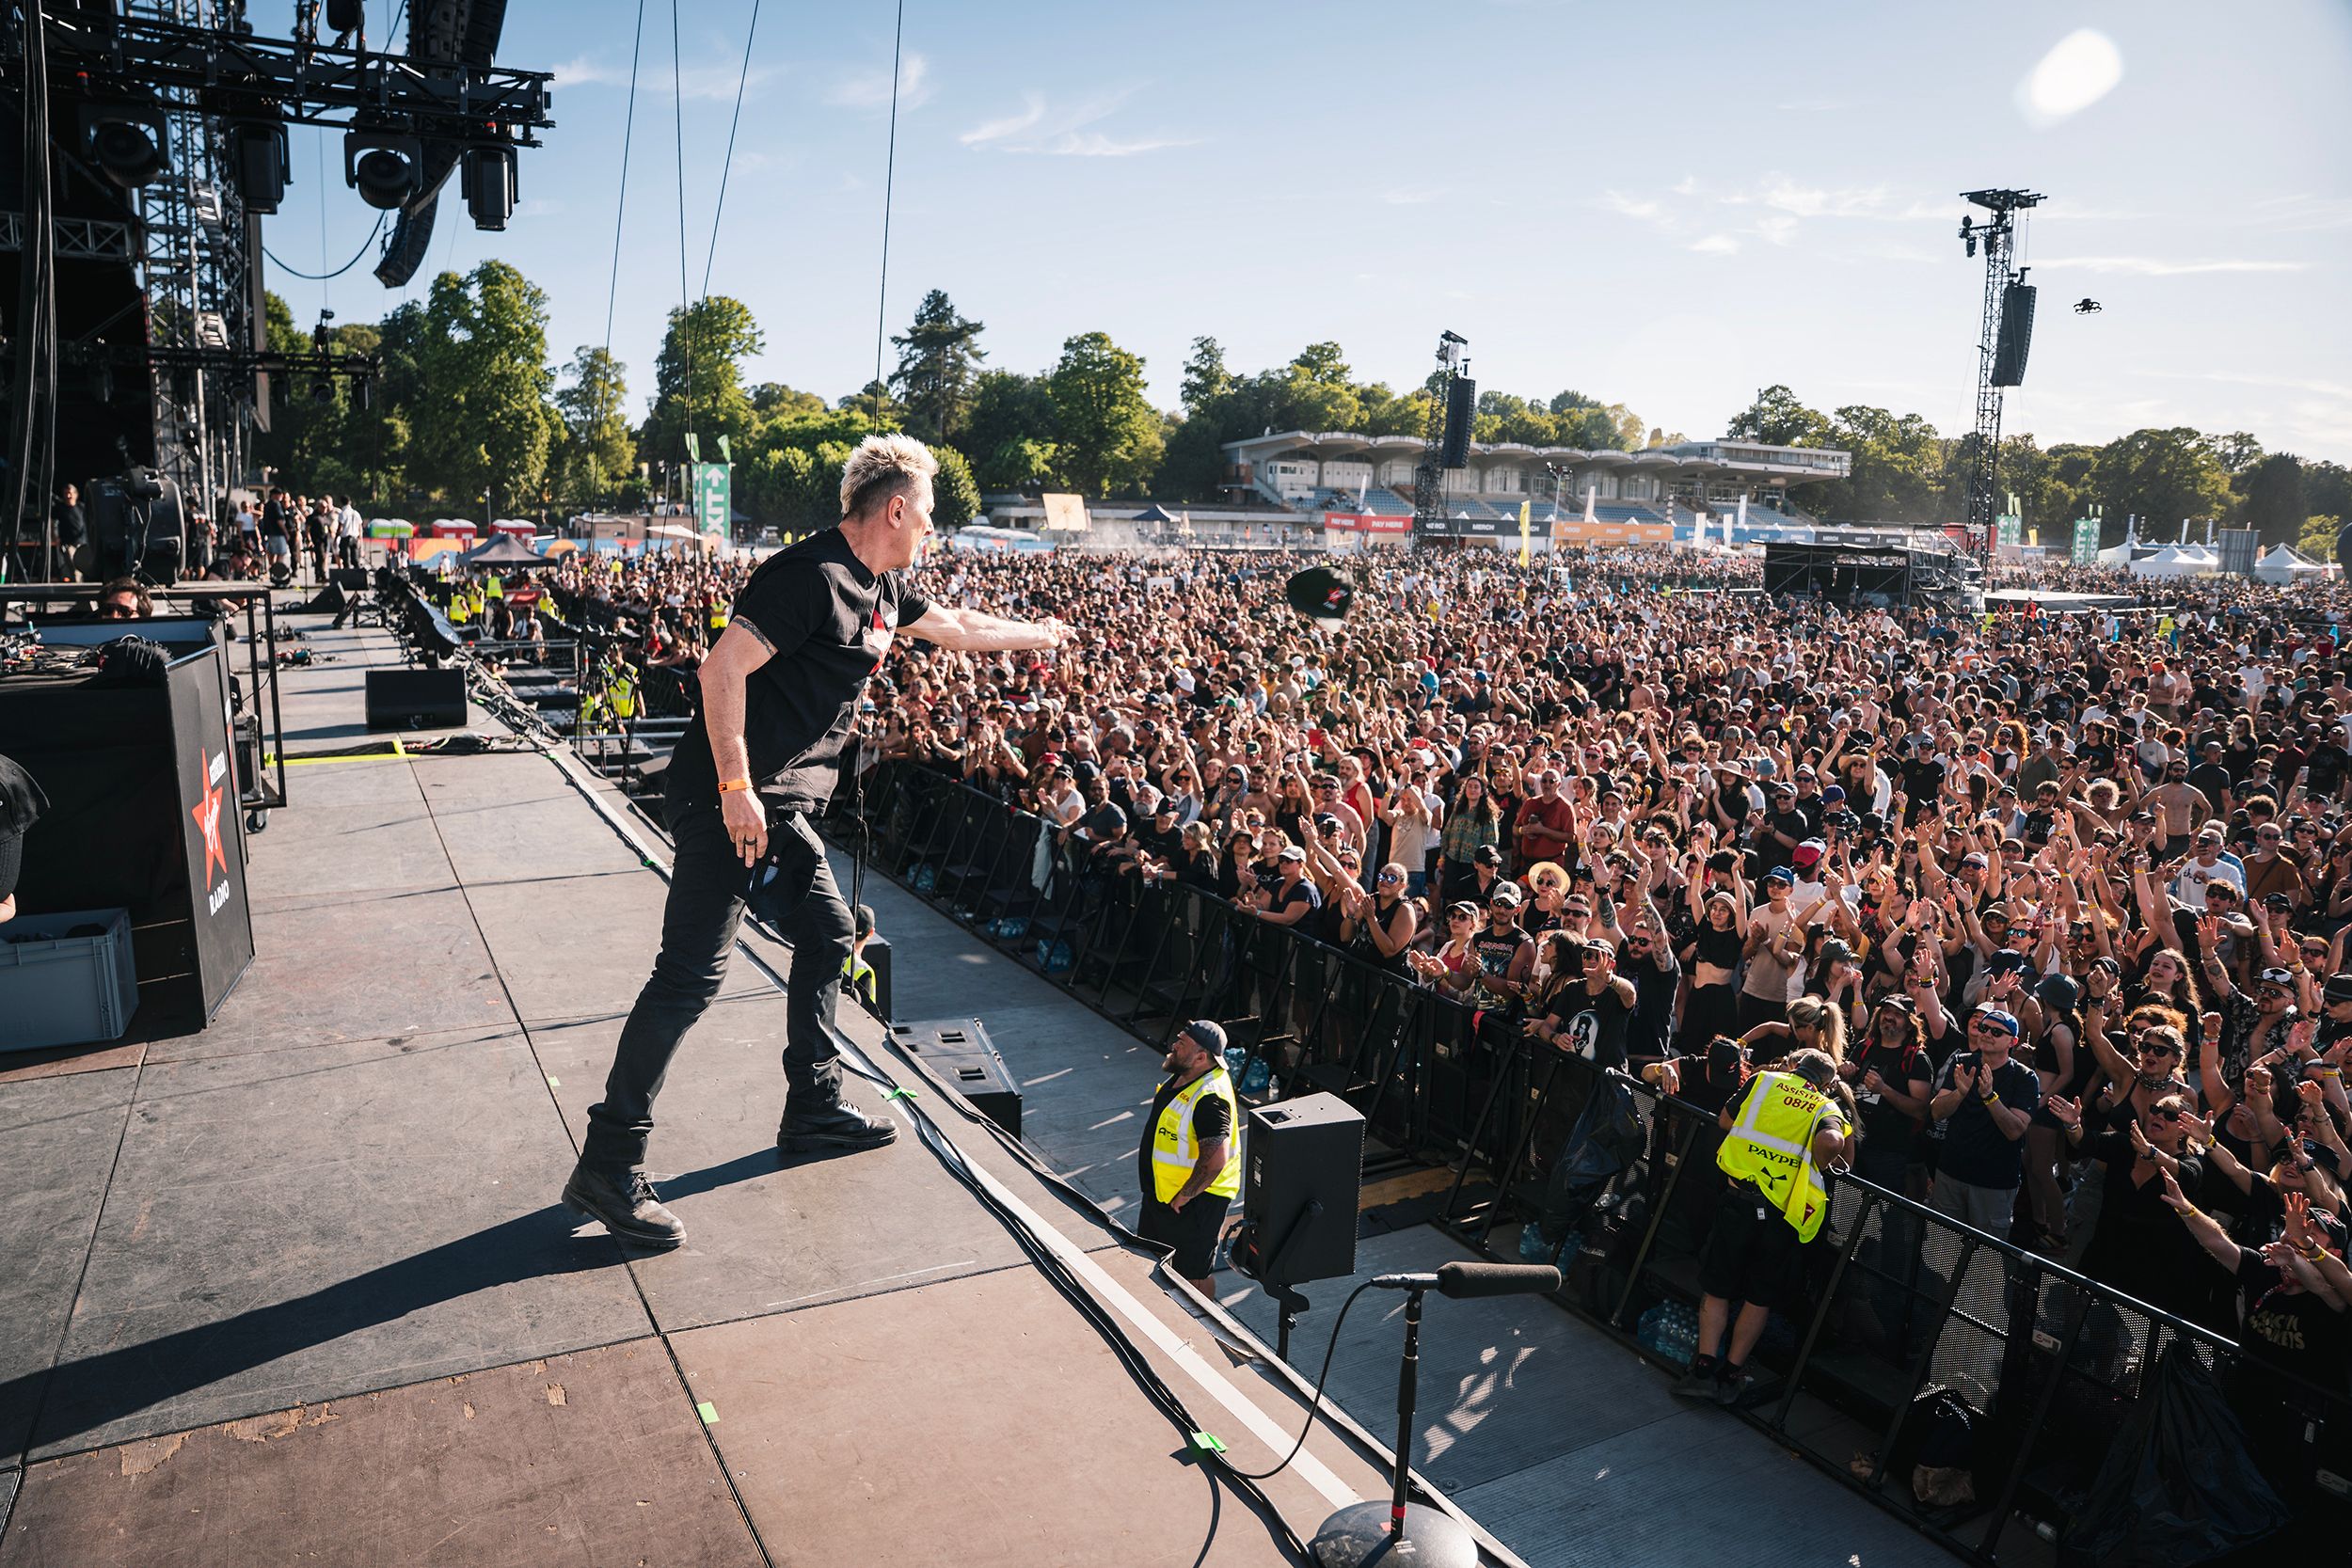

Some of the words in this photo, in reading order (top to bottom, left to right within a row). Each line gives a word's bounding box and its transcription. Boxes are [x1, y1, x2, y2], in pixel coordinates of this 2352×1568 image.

[707, 488, 724, 537] XIT
[209, 879, 230, 916] RADIO
[1783, 1096, 1816, 1114] 0878
[1747, 1144, 1803, 1168] PAYPE
